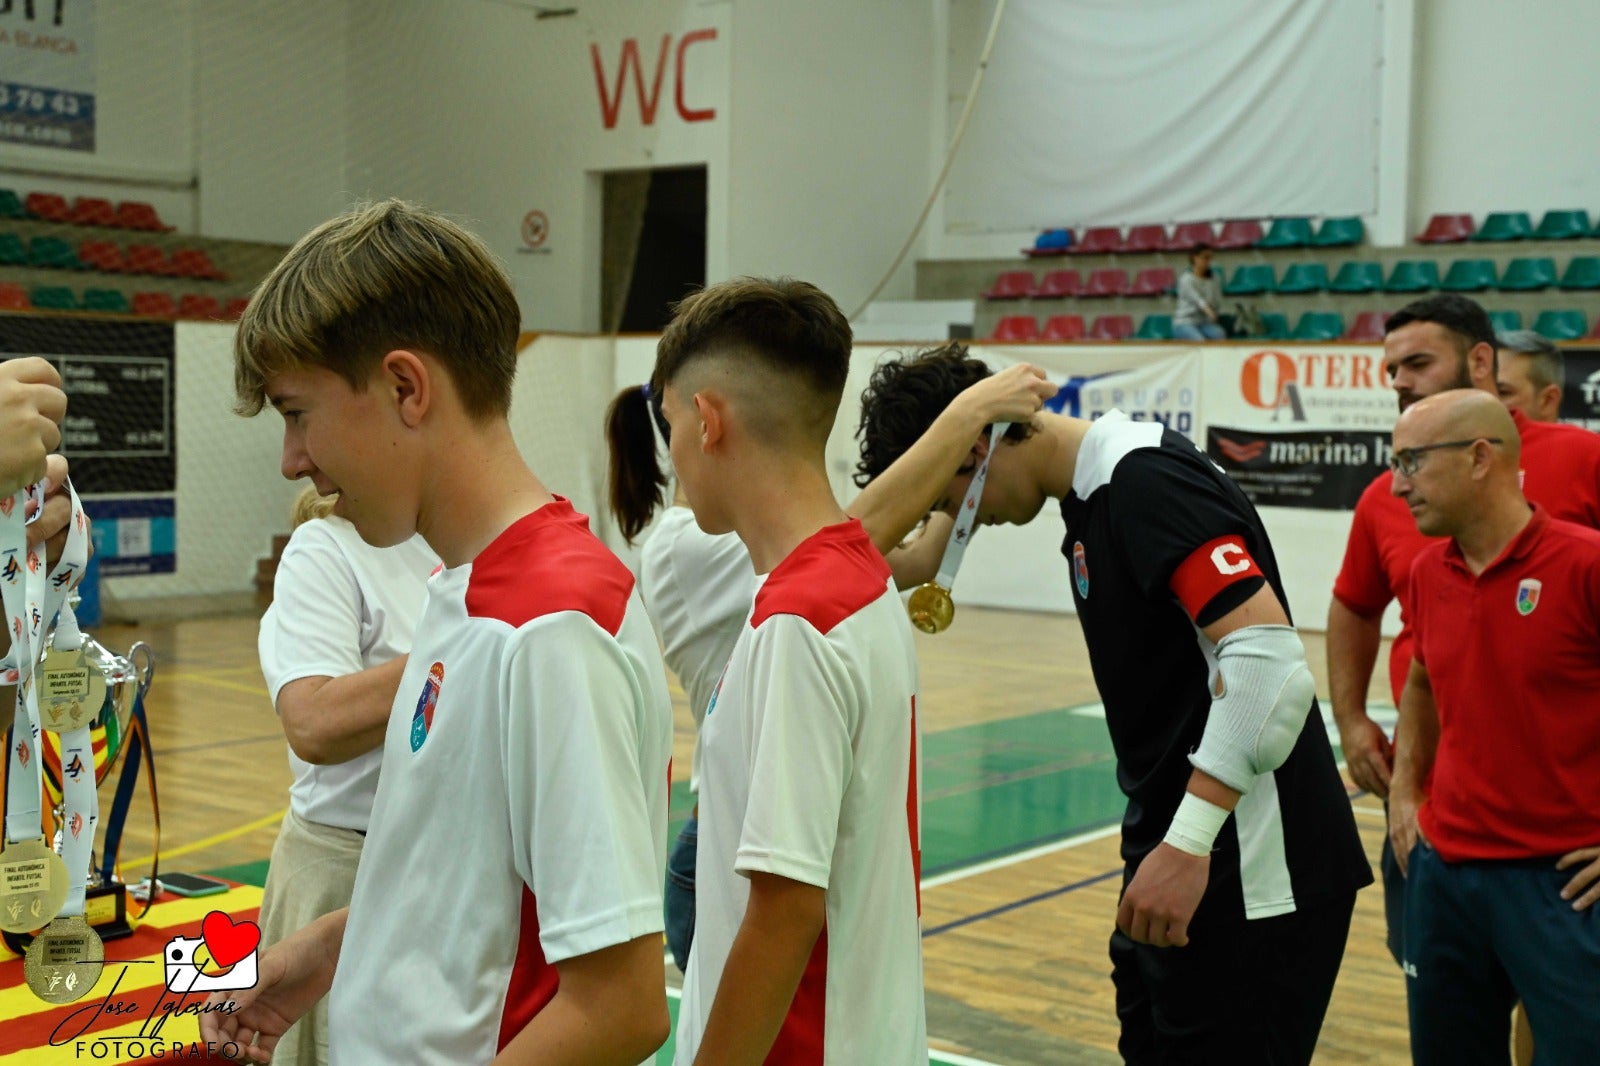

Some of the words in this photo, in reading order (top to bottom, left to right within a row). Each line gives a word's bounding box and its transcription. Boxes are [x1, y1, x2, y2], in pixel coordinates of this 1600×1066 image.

[590, 28, 718, 130] WC
[15, 88, 45, 112] 70
[1089, 387, 1193, 406] GRUPO
[1269, 435, 1369, 466] marina
[1209, 542, 1251, 575] C
[7, 874, 26, 882] INFANTIL
[26, 872, 43, 880] FUTSAL
